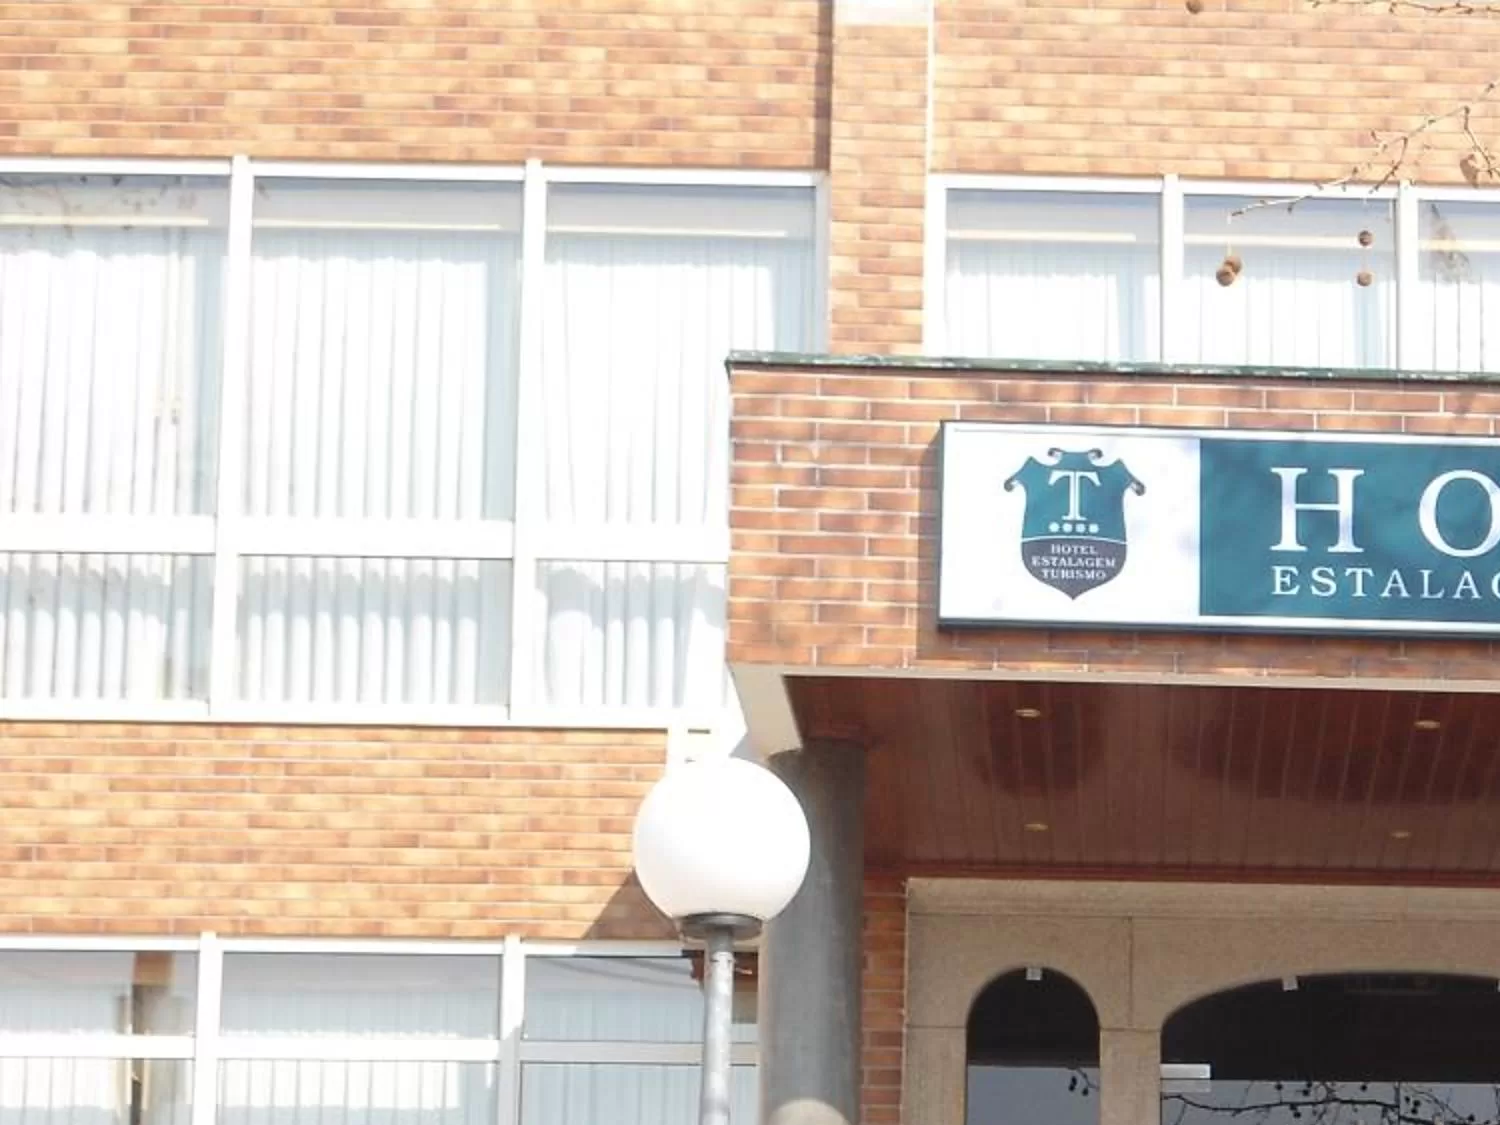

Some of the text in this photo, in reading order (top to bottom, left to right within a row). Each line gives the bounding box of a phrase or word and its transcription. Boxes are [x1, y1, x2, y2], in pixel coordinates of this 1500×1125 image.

[1048, 470, 1101, 521] T
[1051, 544, 1098, 555] HOTEL
[1031, 556, 1116, 569] ESTALAGEM
[1043, 569, 1106, 580] TURISMO
